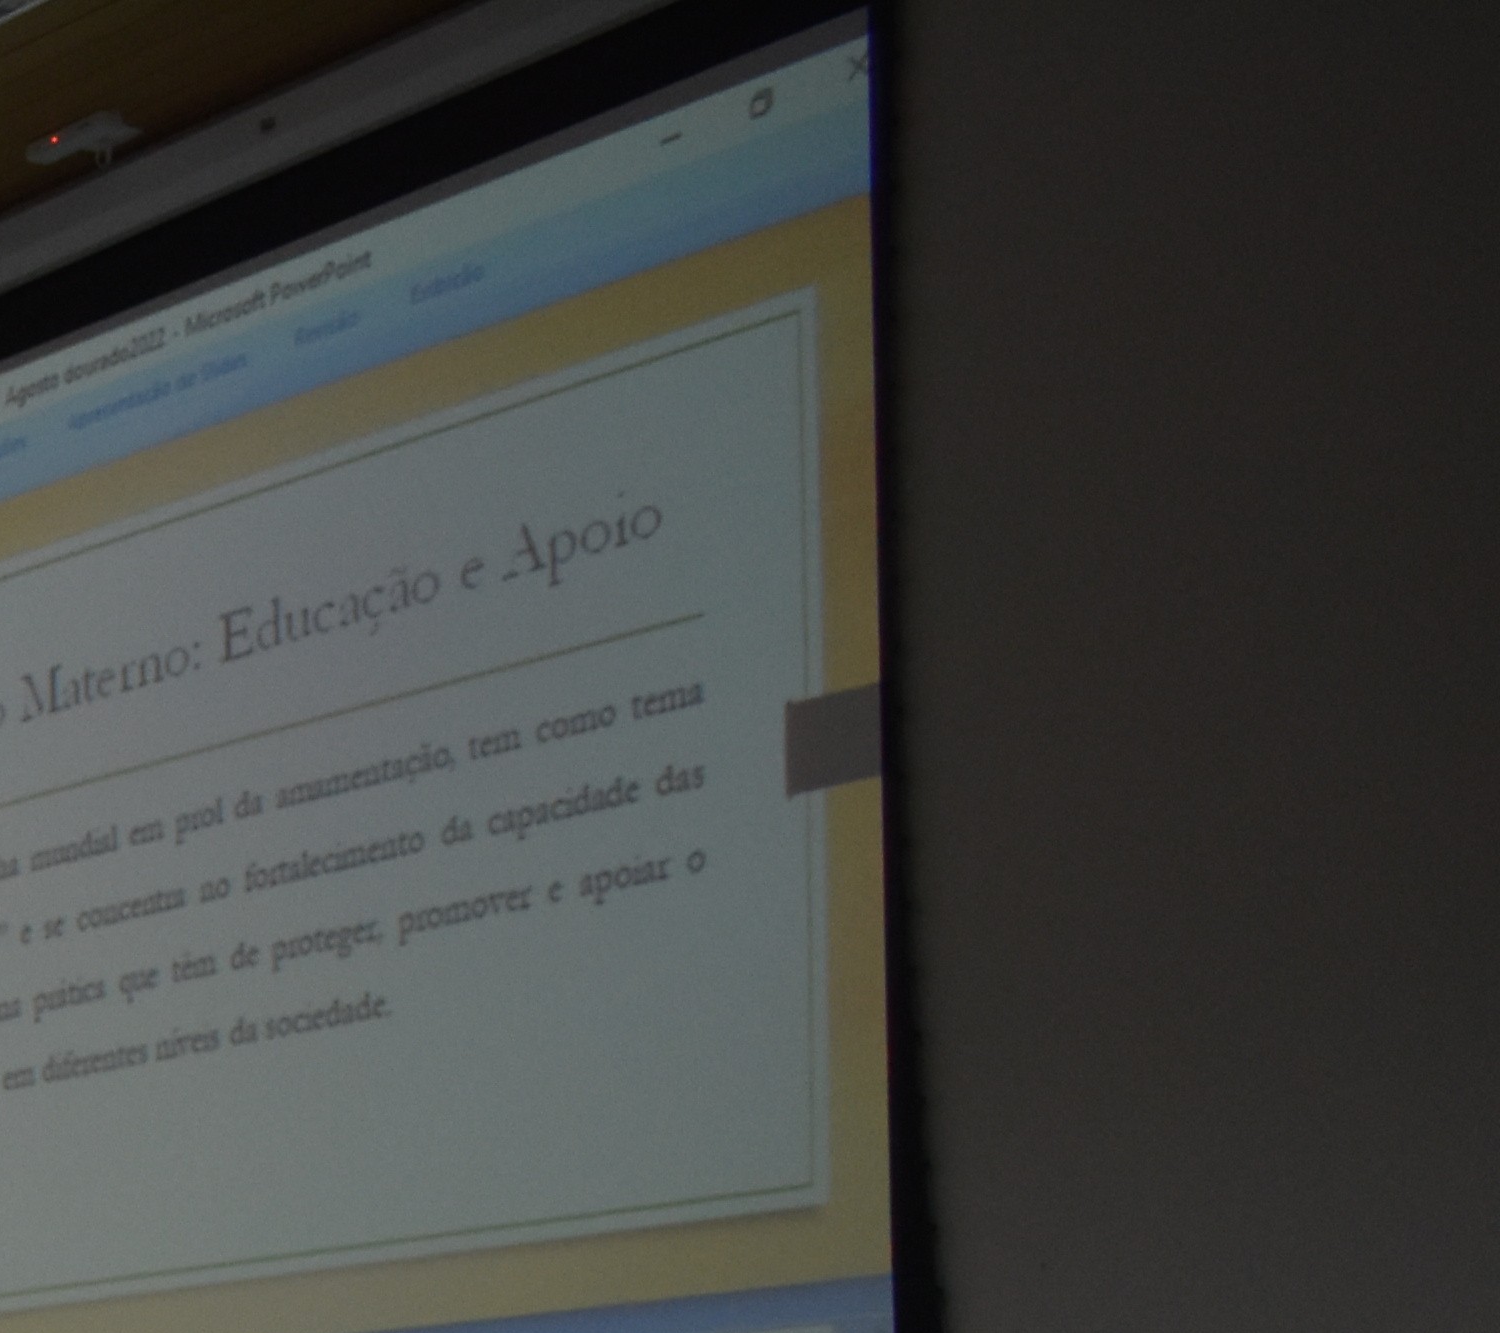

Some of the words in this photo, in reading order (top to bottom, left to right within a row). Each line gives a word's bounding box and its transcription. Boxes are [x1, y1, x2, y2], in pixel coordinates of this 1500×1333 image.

[5, 371, 59, 407] Agosto
[183, 289, 267, 336] Microsoft
[270, 250, 372, 306] PowerPoint
[20, 641, 201, 722] Materno:
[218, 566, 441, 665] Educação
[460, 555, 484, 590] e
[502, 491, 662, 587] Apoio
[19, 925, 32, 945] e
[43, 916, 65, 940] se
[76, 884, 186, 932] concentra
[198, 875, 230, 902] no
[244, 830, 425, 895] fortalecimento
[441, 815, 473, 847] da
[487, 776, 640, 840] capacidade
[654, 763, 706, 799] das
[30, 824, 118, 871] mundial
[129, 818, 164, 846] em
[175, 796, 224, 845] prol
[235, 789, 262, 821] da
[468, 725, 521, 760] tem
[534, 704, 616, 745] como
[629, 679, 706, 720] tema
[33, 977, 105, 1023] prática
[118, 968, 158, 1004] que
[230, 940, 258, 971] de
[271, 917, 382, 973] proteger,
[398, 883, 533, 945] promover
[547, 880, 563, 902] e
[580, 853, 672, 905] apoiar
[686, 850, 706, 873] o
[3, 1066, 35, 1090] em
[42, 1043, 148, 1083] diferentes
[155, 1017, 219, 1063] níveis
[230, 1017, 257, 1046] da
[265, 991, 393, 1041] sociedade.
